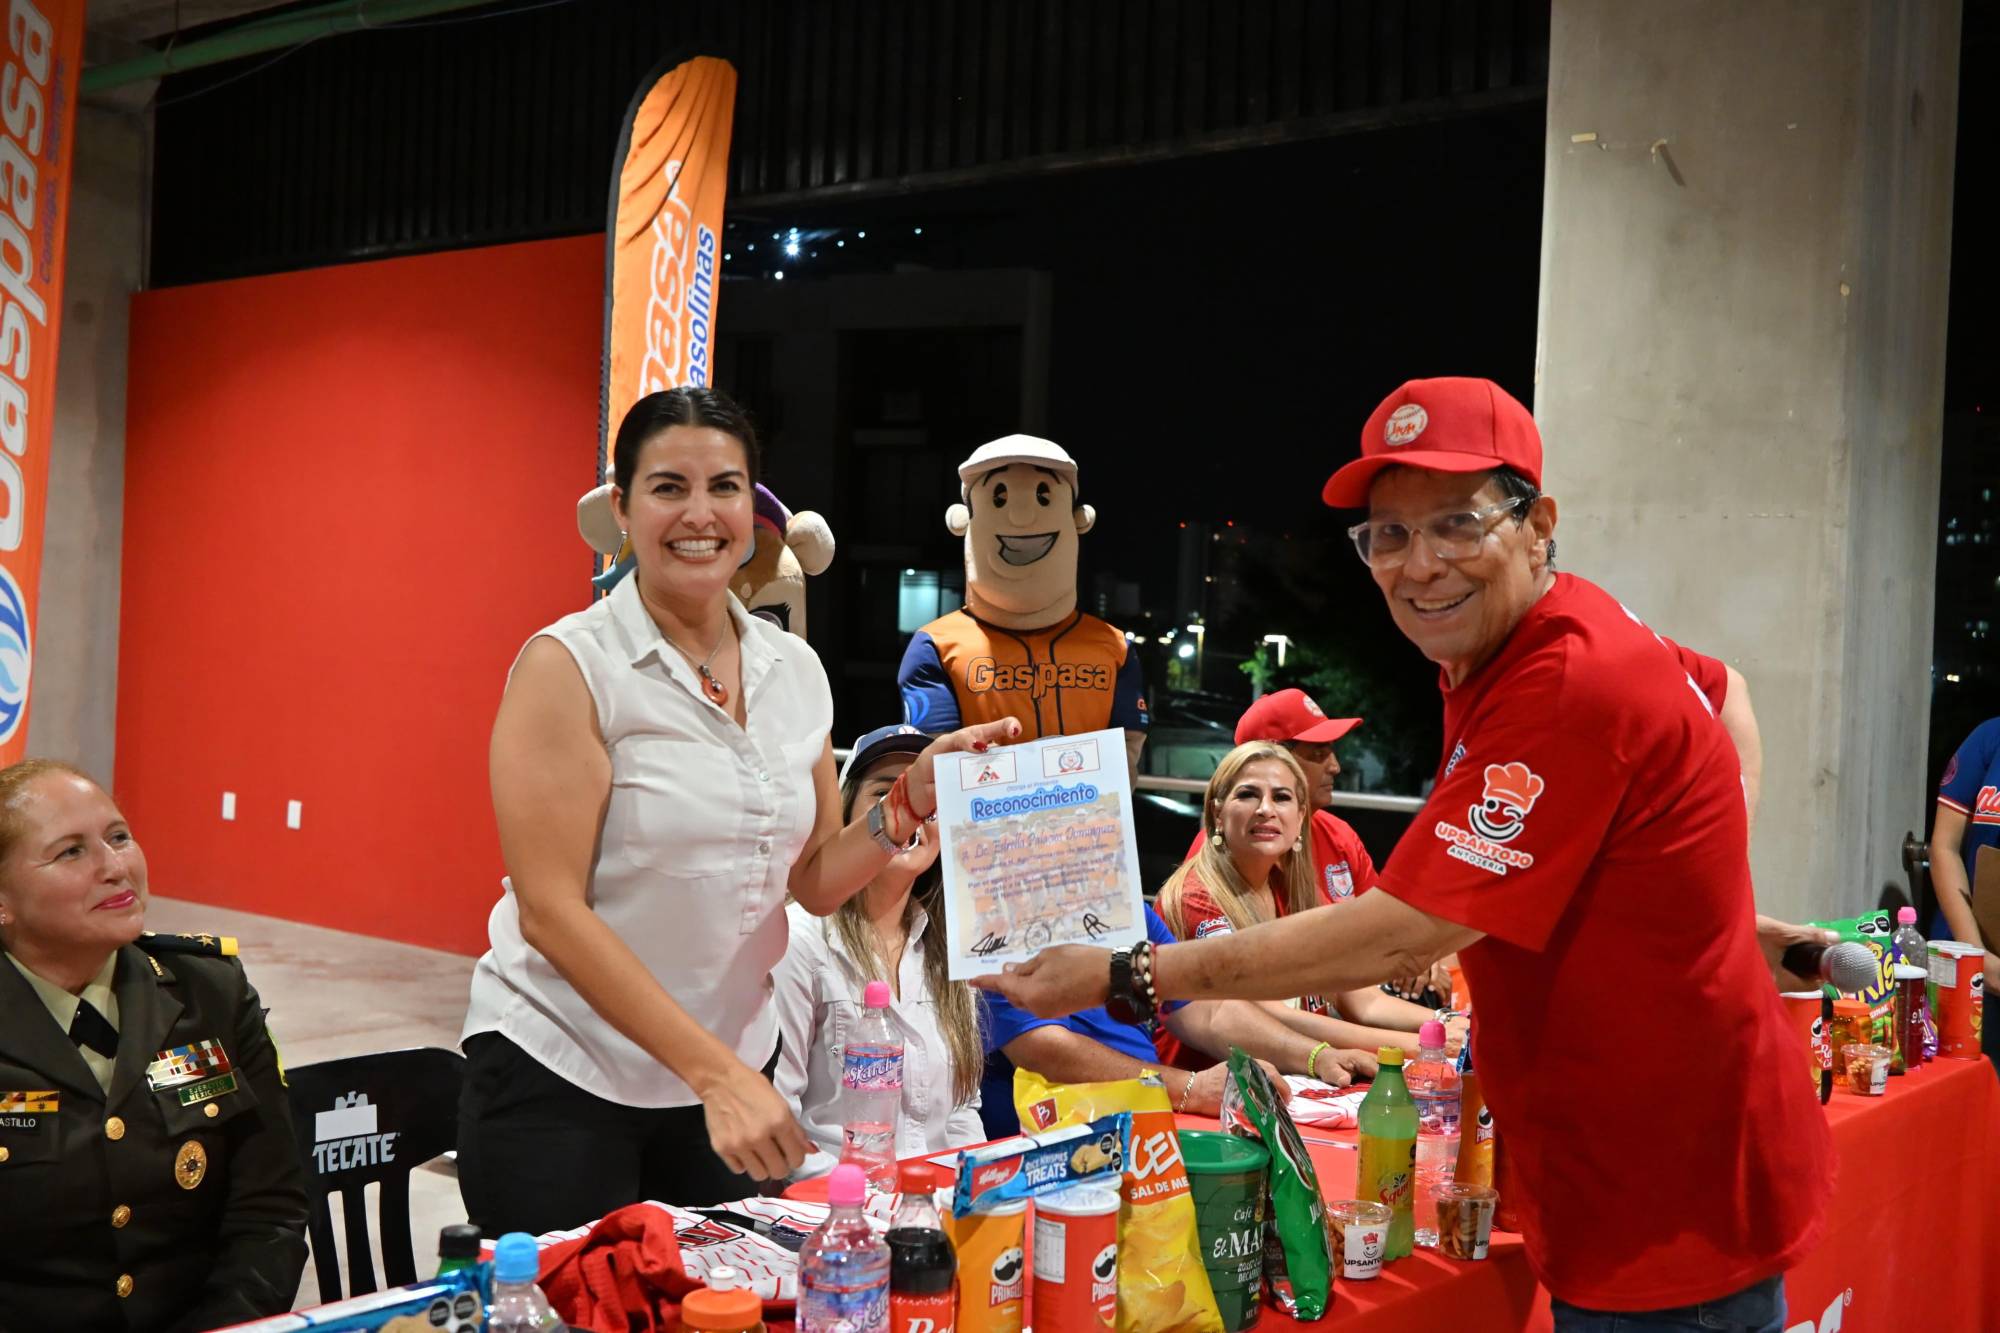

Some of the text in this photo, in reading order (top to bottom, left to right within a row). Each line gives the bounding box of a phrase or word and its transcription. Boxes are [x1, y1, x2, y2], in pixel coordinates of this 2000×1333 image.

[0, 0, 50, 551] aspasa
[687, 226, 715, 390] asolinas
[967, 657, 1113, 699] Gaspasa
[973, 783, 1097, 819] Reconocimiento
[1436, 823, 1533, 868] UPSANTOJO
[1448, 846, 1505, 873] ANTOJERIA
[312, 1132, 397, 1174] TECATE
[1026, 1162, 1067, 1187] TREATS
[1131, 1176, 1190, 1200] SAL DE ME
[1228, 1224, 1262, 1258] MA
